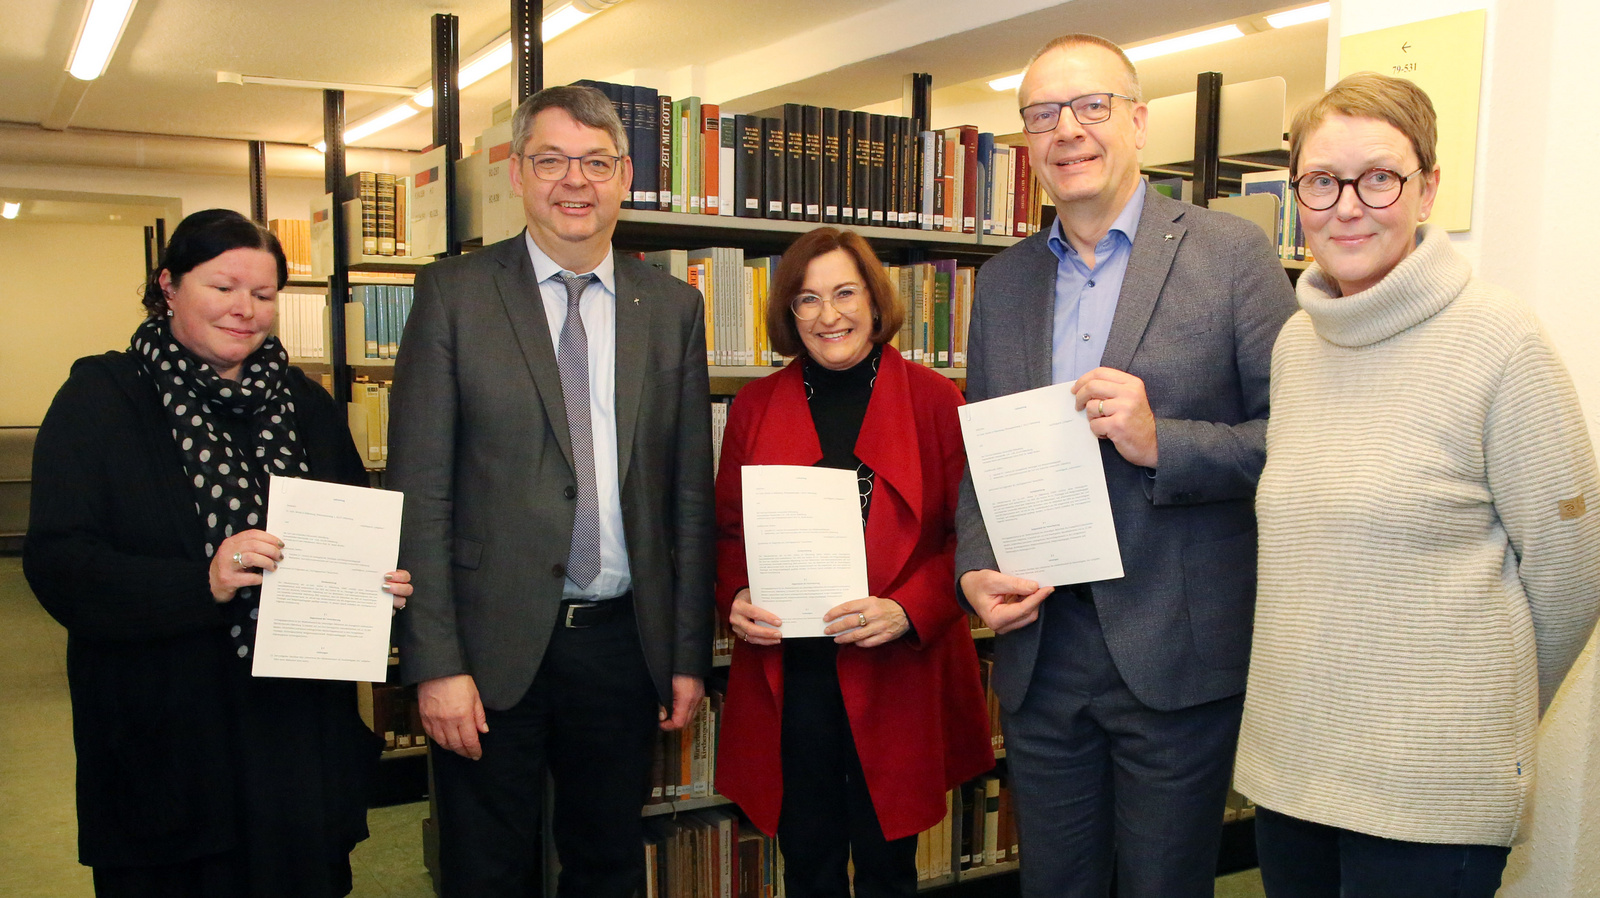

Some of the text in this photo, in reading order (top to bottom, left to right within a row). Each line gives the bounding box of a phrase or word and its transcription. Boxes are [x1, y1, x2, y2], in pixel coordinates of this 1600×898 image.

[1392, 62, 1417, 74] 79-531
[662, 99, 670, 126] GOTT
[662, 126, 670, 145] MIT
[662, 145, 670, 168] ZEIT
